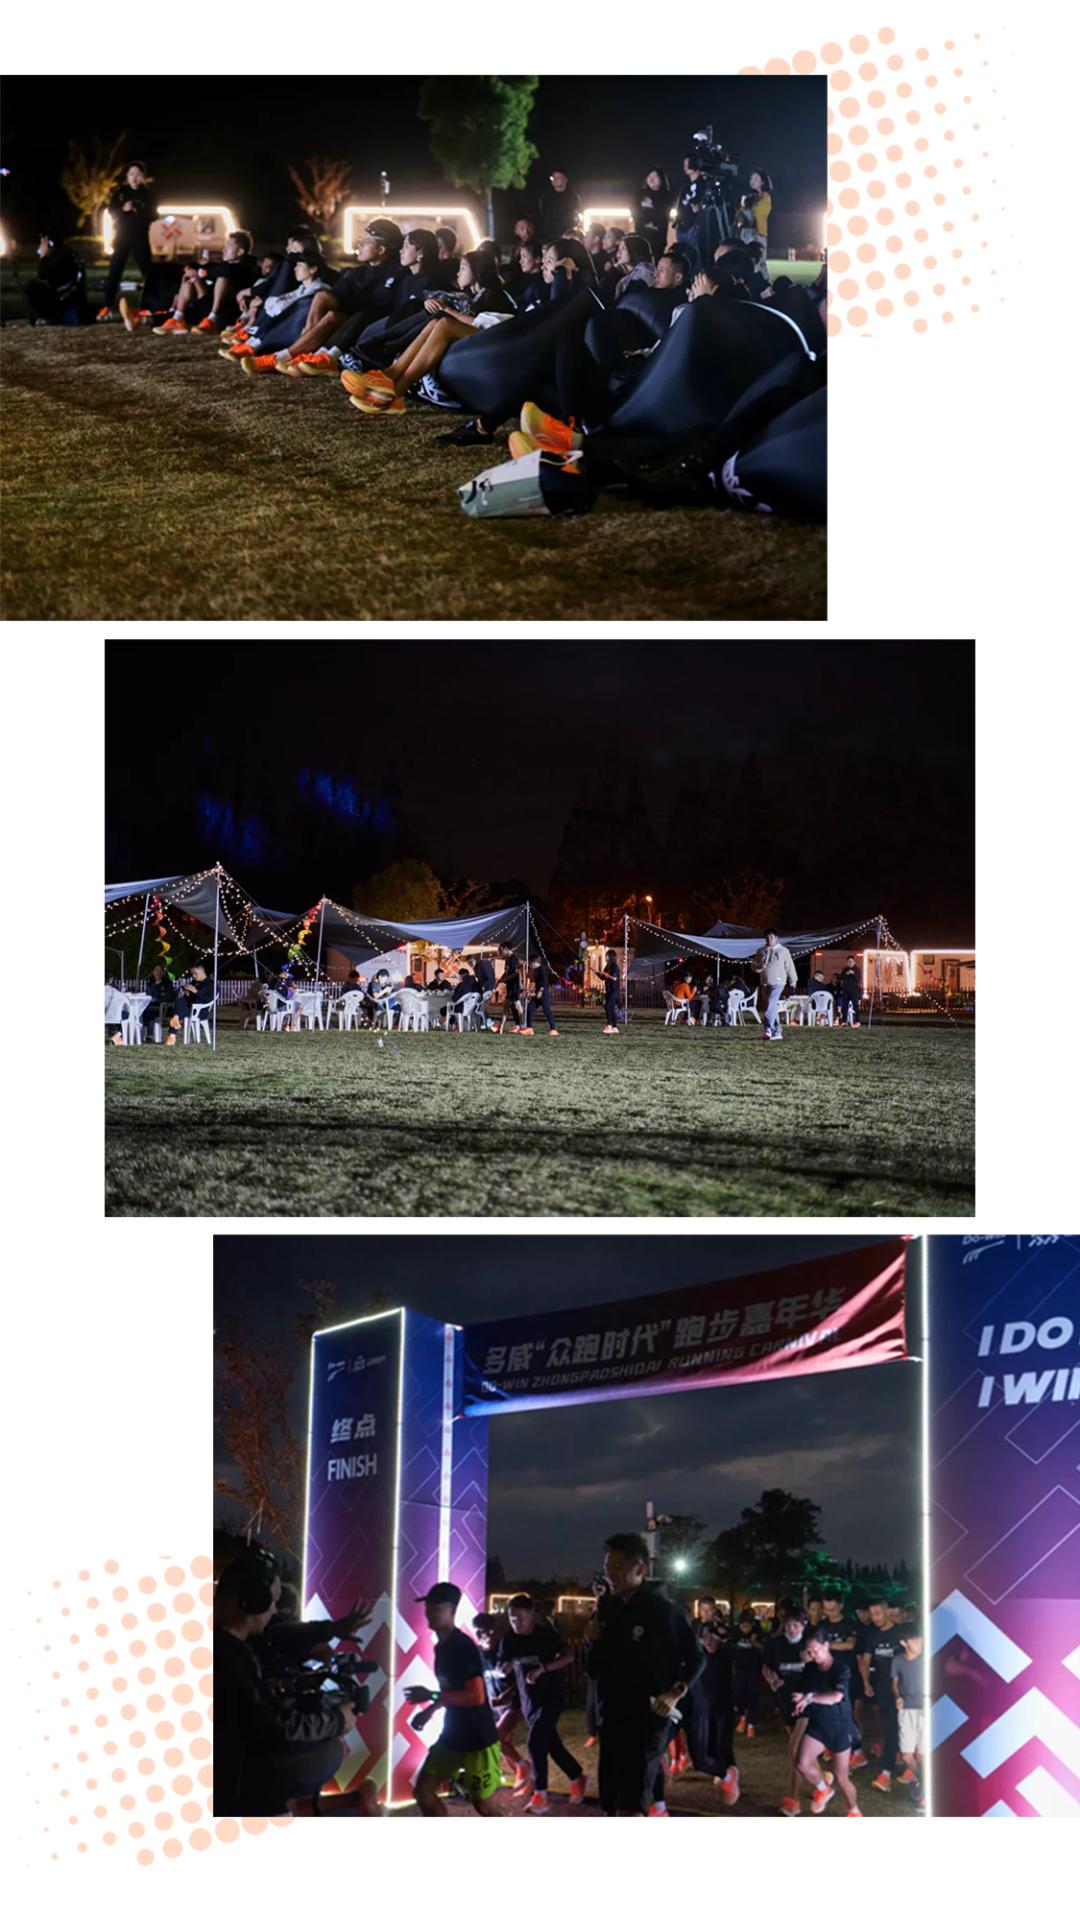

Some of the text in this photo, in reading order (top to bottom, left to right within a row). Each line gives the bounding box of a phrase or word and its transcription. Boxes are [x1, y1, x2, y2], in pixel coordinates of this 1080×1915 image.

[978, 1316, 1074, 1357] I DO
[532, 1360, 662, 1389] ZHONGPAOSHIDAI
[667, 1345, 746, 1369] RUNNING
[749, 1328, 842, 1355] CARNIVAL
[978, 1376, 994, 1408] I
[330, 1413, 376, 1443] 终点
[327, 1453, 377, 1481] FINISH
